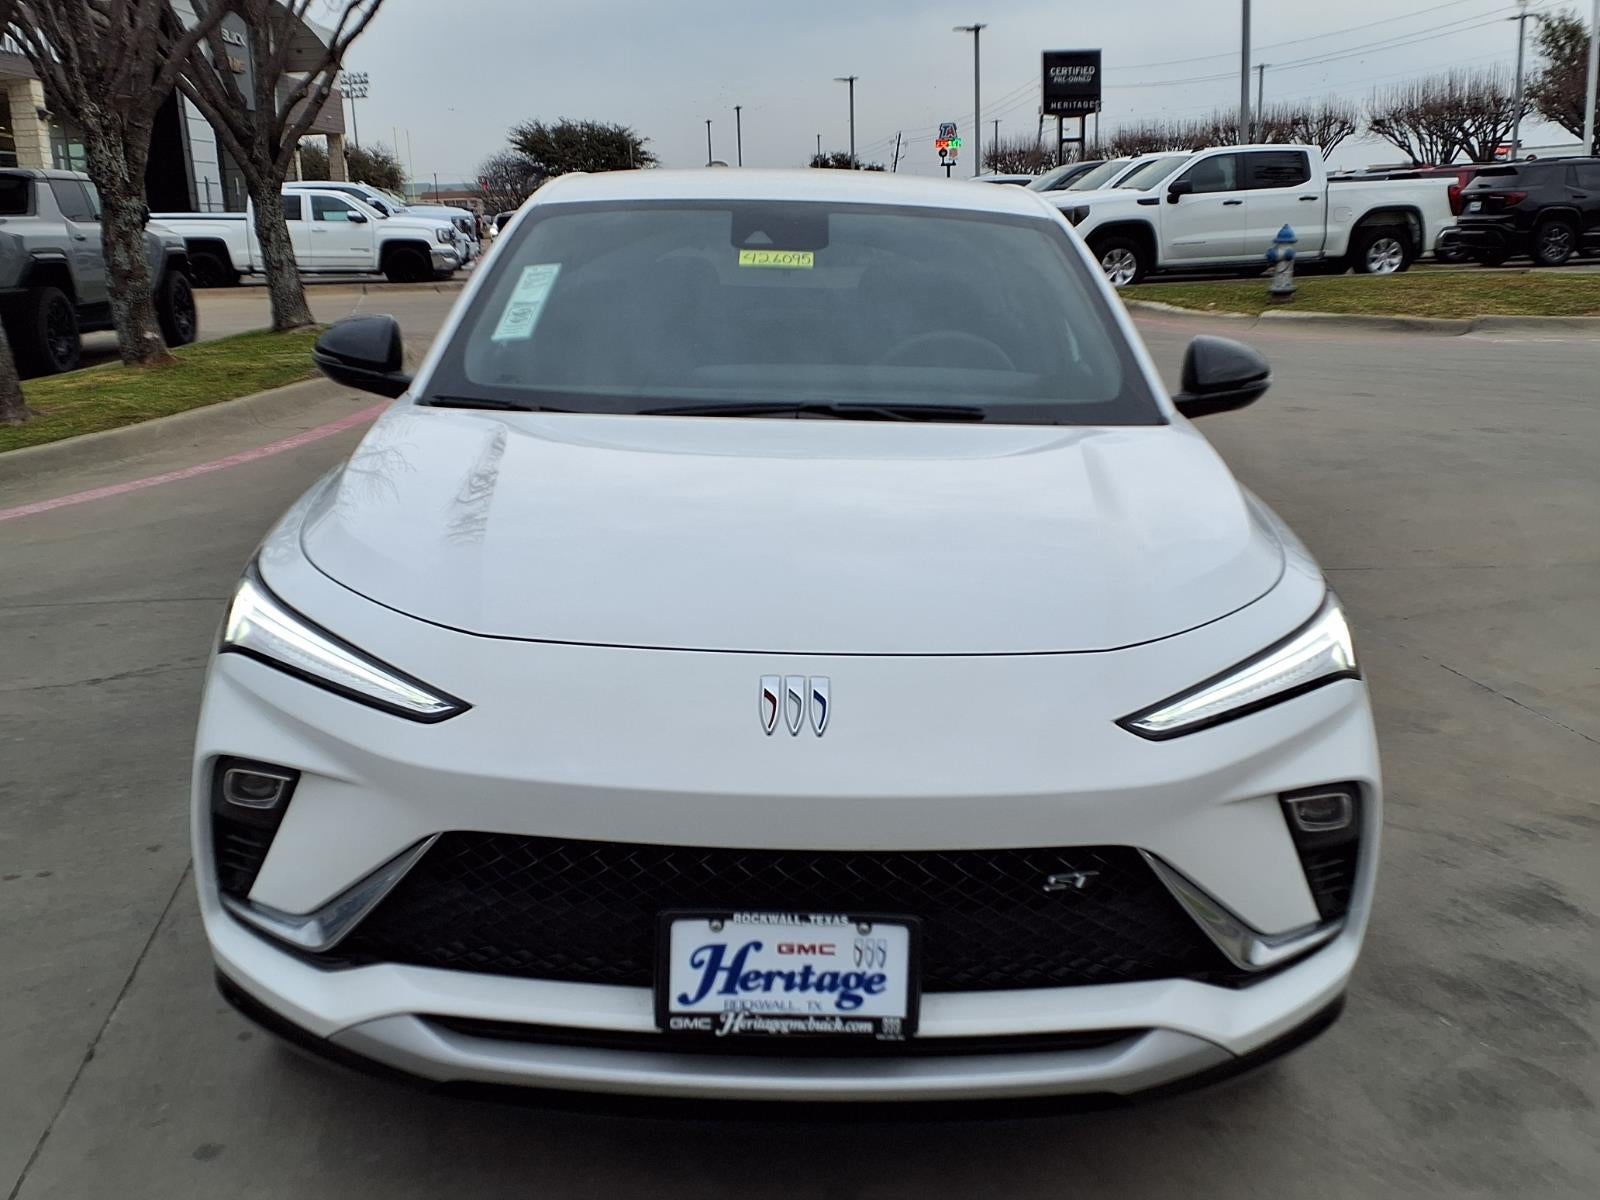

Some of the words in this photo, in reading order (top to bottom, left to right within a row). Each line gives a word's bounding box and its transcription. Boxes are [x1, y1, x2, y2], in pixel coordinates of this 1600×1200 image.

[1050, 66, 1095, 76] CERTIFIED
[1050, 100, 1096, 110] HERITAGE
[808, 913, 849, 927] TEXAS
[777, 943, 836, 956] GMC
[677, 941, 887, 1010] Heritage
[670, 1017, 712, 1030] GMC
